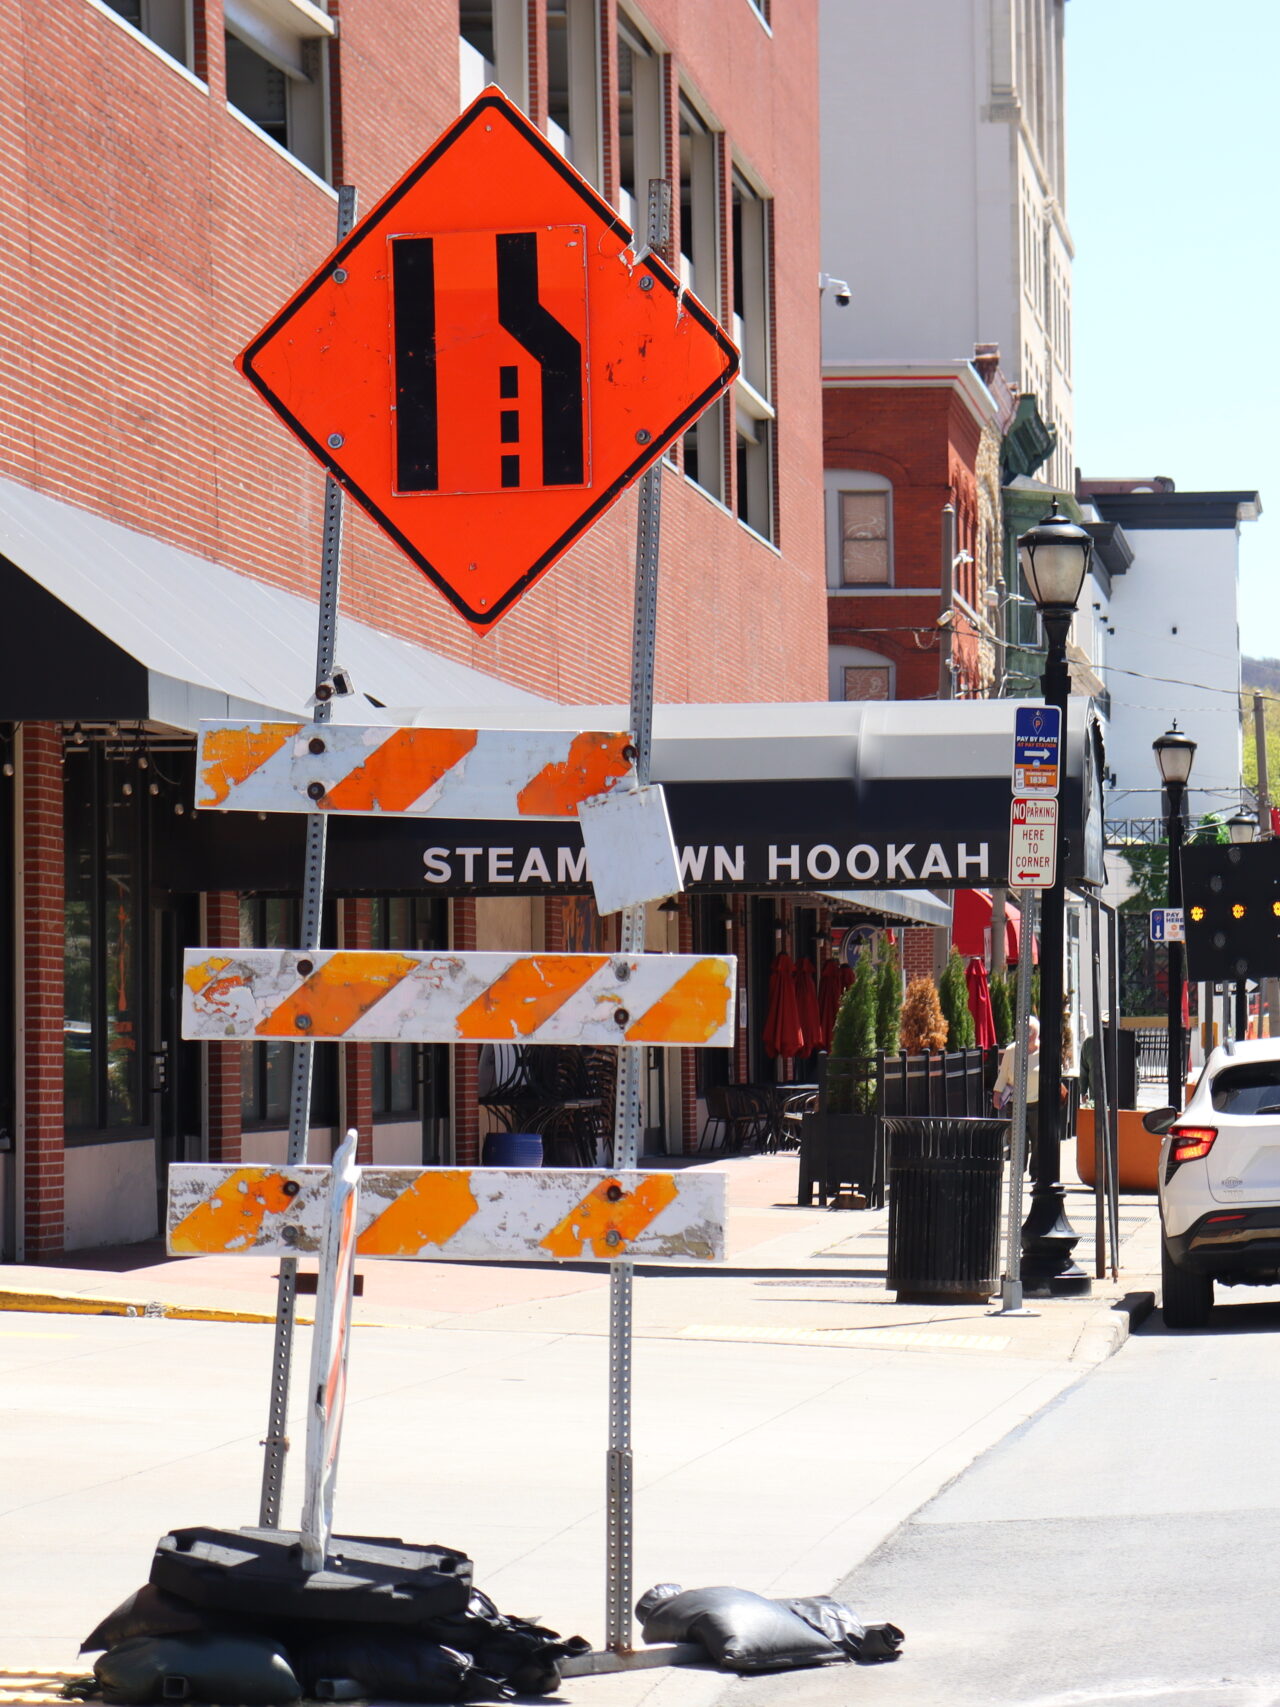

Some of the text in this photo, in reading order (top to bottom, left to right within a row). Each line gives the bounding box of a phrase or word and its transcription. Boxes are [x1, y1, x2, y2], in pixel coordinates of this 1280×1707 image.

[1013, 803, 1055, 819] NO PARKING
[1023, 829, 1045, 840] HERE
[1028, 843, 1039, 854] TO
[423, 842, 989, 883] STEAMWN HOOKAH
[1016, 856, 1050, 868] CORNER
